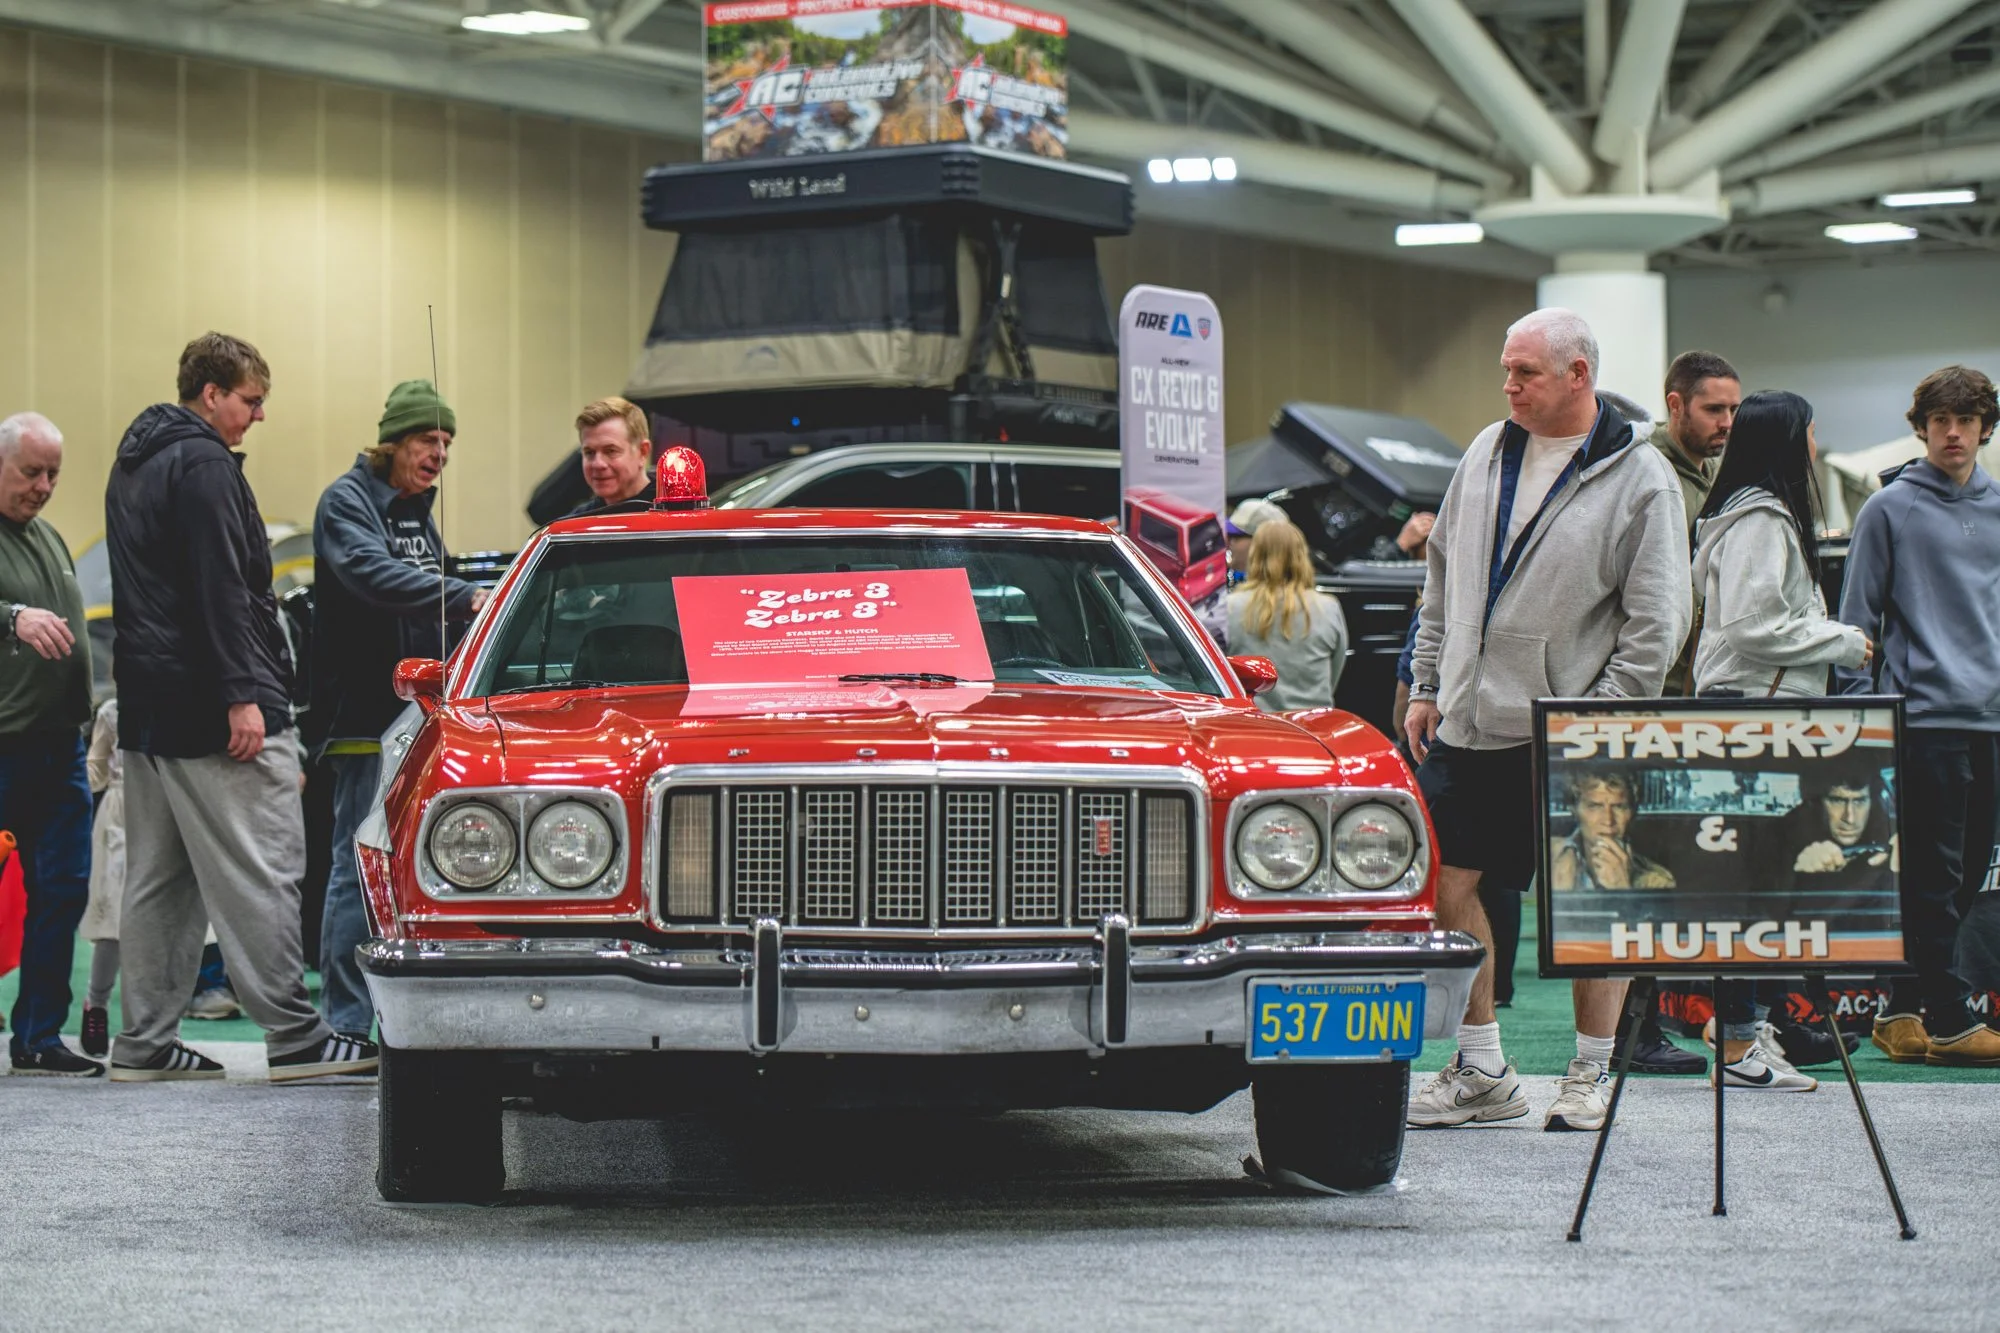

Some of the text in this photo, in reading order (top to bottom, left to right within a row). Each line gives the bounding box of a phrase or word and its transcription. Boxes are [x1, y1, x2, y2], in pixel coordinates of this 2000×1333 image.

[799, 172, 847, 196] Land
[1130, 365, 1154, 406] CX
[1158, 368, 1202, 412] REVO
[1144, 410, 1208, 454] EVOLVE
[864, 582, 890, 599] 3
[744, 609, 842, 628] Zebra
[786, 629, 832, 637] STARSKY
[1561, 721, 1863, 758] STARSKY
[1695, 815, 1738, 852] &
[1610, 920, 1830, 959] HUTCH
[1296, 984, 1381, 996] CALIFORNIA
[1260, 1001, 1330, 1043] 537
